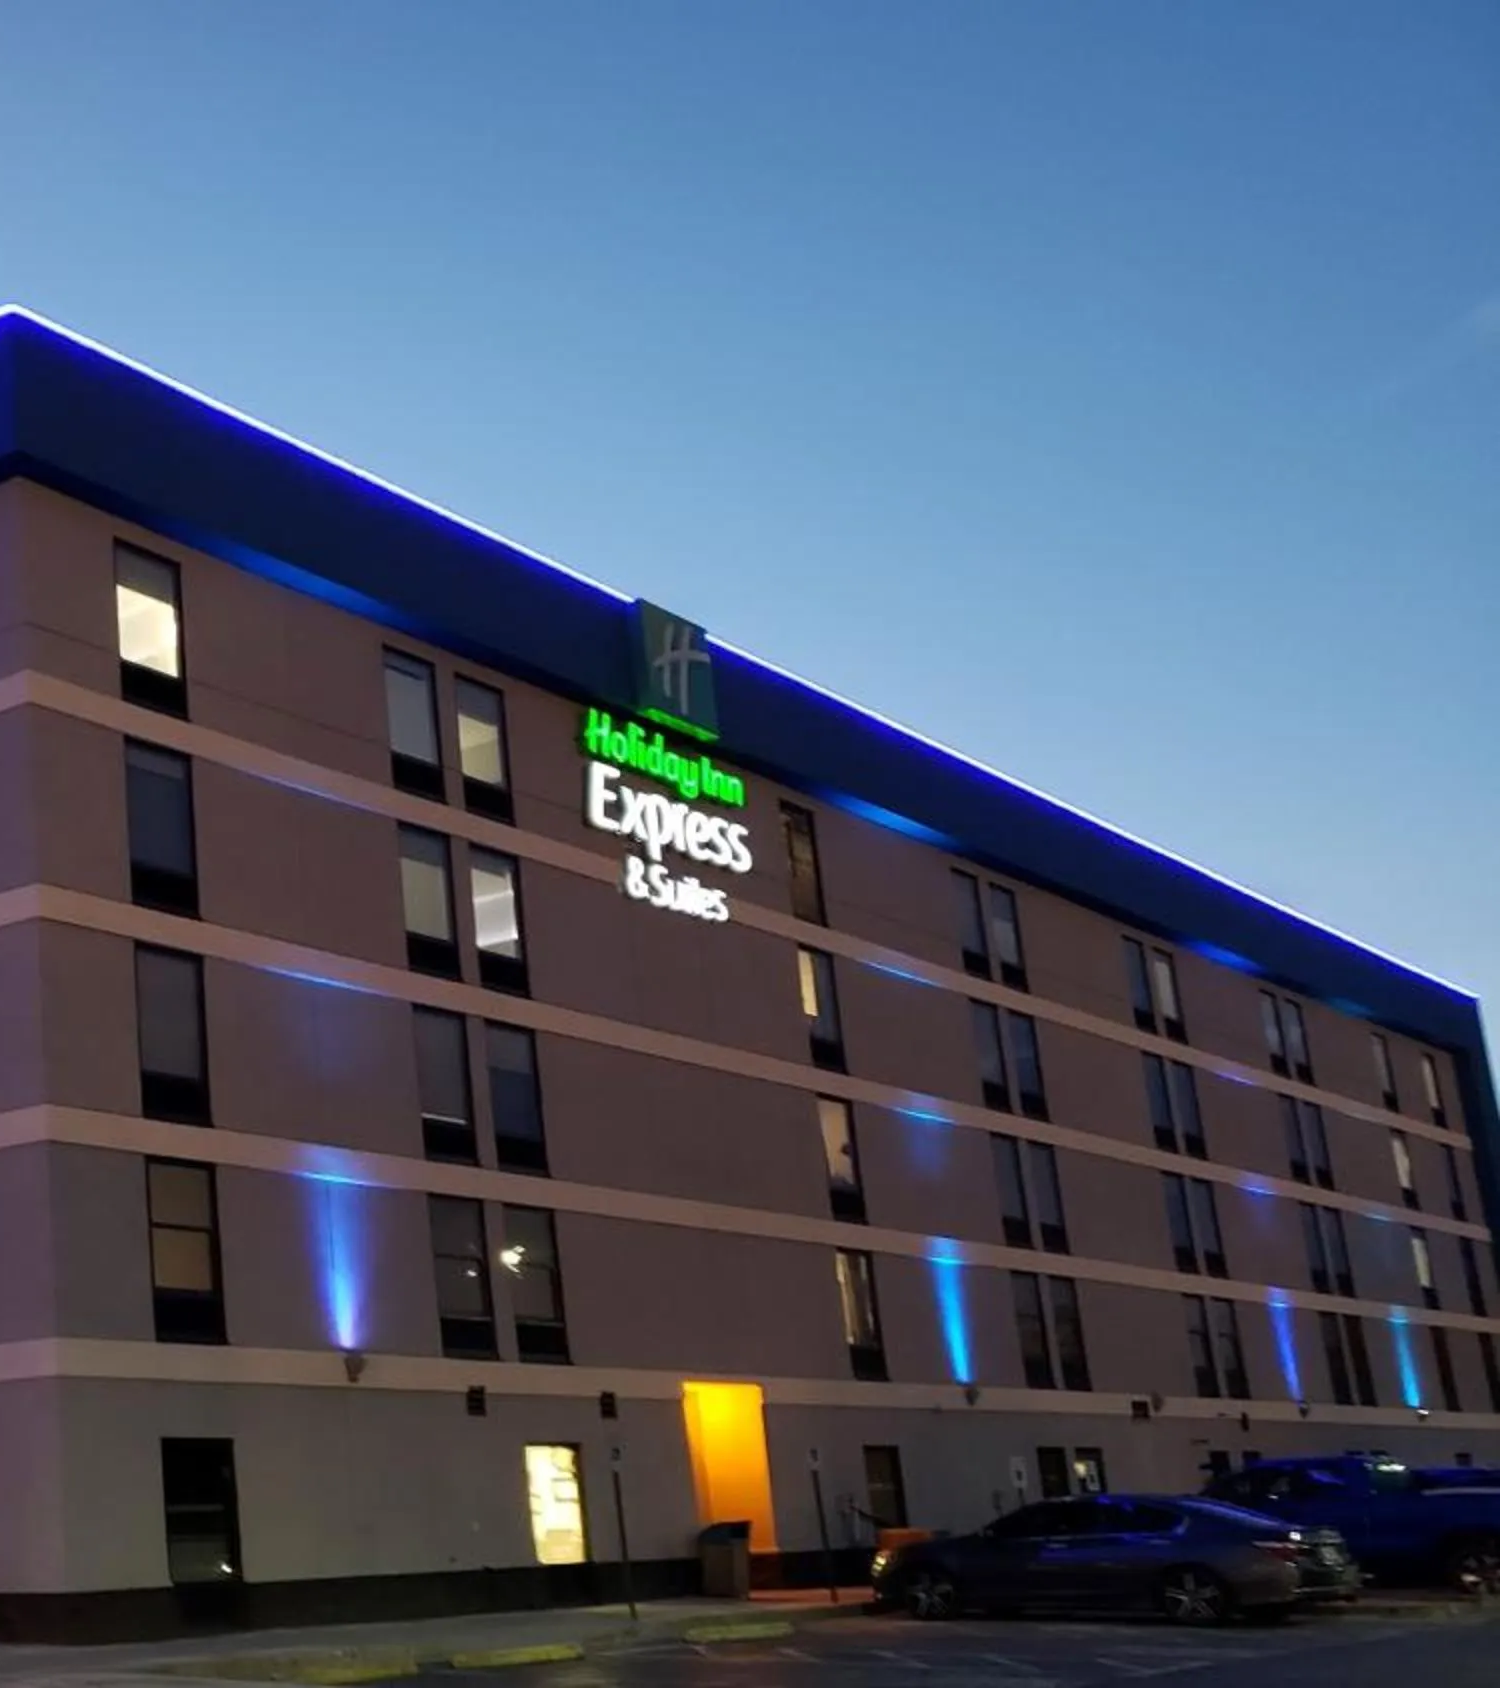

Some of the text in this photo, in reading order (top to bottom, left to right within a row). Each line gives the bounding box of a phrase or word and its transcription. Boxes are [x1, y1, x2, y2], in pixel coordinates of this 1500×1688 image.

[654, 621, 711, 716] H
[585, 707, 745, 806] Holiday Inn
[589, 761, 753, 873] Express
[625, 855, 730, 922] & Suites
